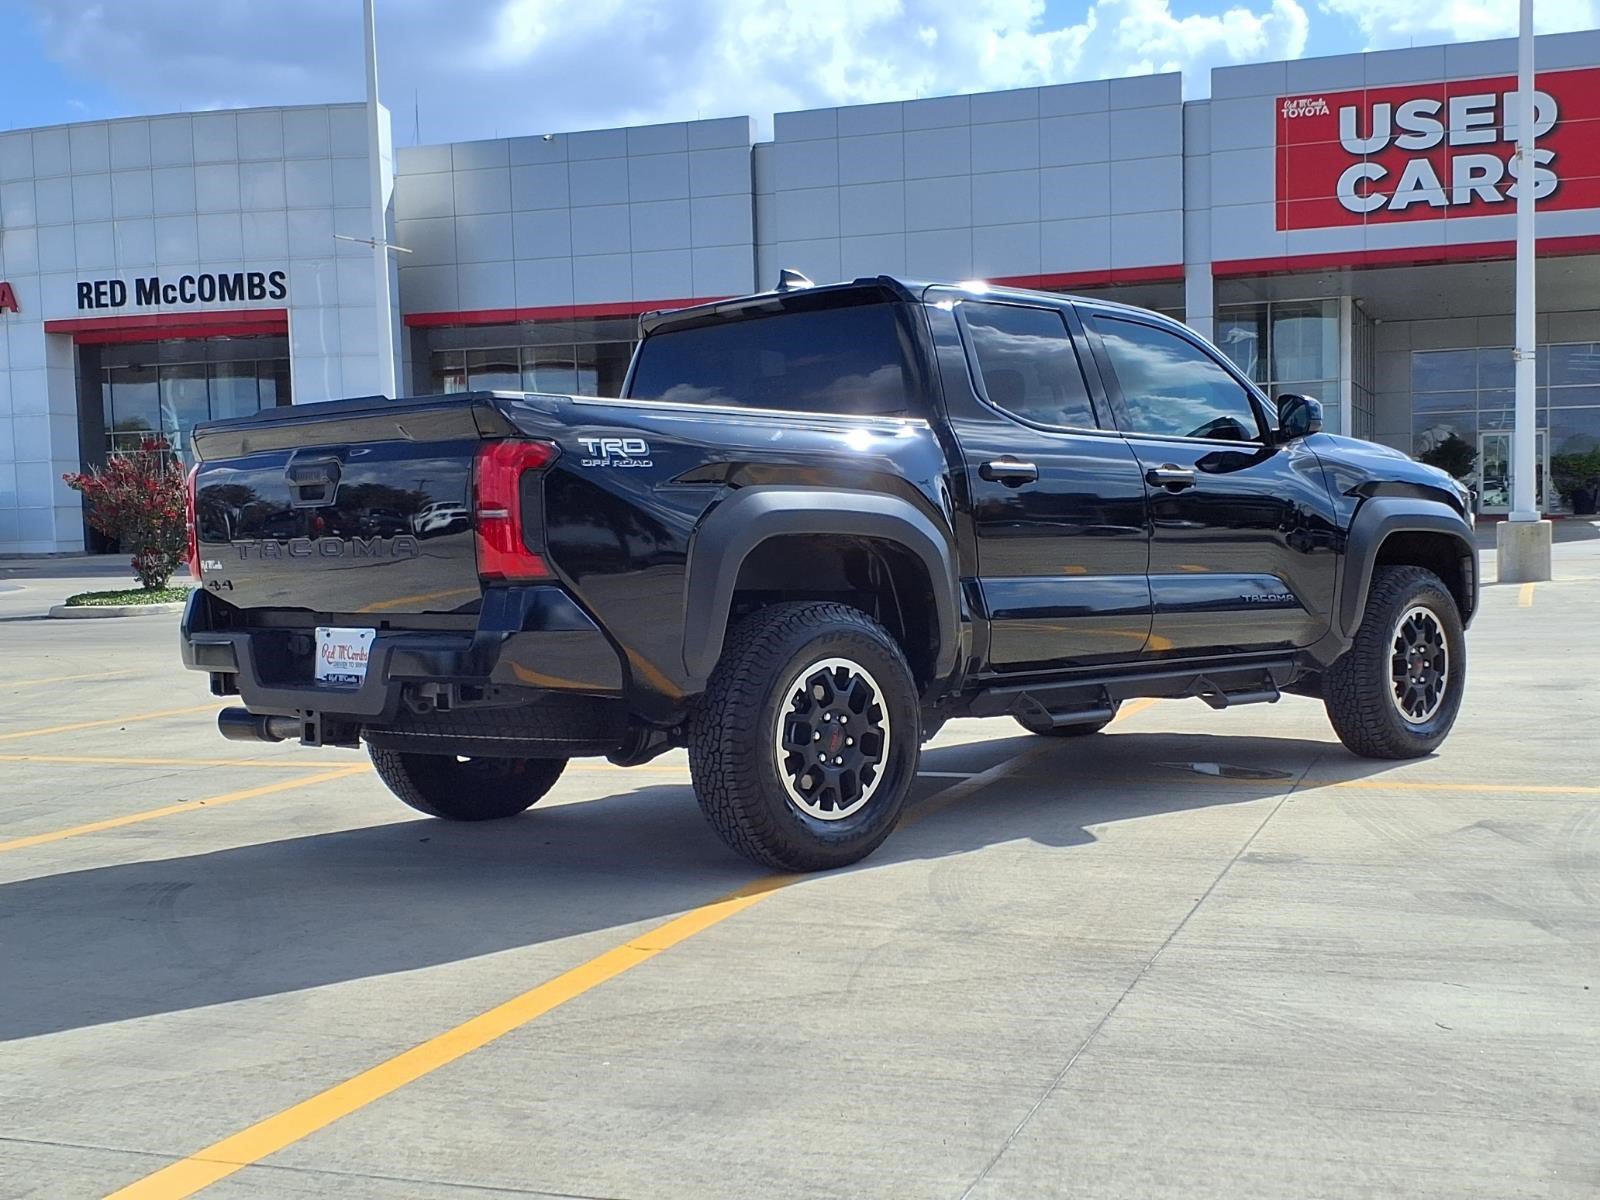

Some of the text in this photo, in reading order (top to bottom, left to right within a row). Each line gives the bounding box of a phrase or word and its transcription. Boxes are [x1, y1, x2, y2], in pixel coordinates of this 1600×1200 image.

[1281, 105, 1330, 118] TOYOTA
[1339, 90, 1558, 154] USED
[1336, 149, 1558, 213] CARS
[77, 271, 287, 309] RED McCOMBS
[578, 437, 650, 458] TRD
[581, 459, 653, 467] OFF ROAD
[231, 535, 420, 560] TACOMA
[1241, 594, 1295, 602] TACOMA
